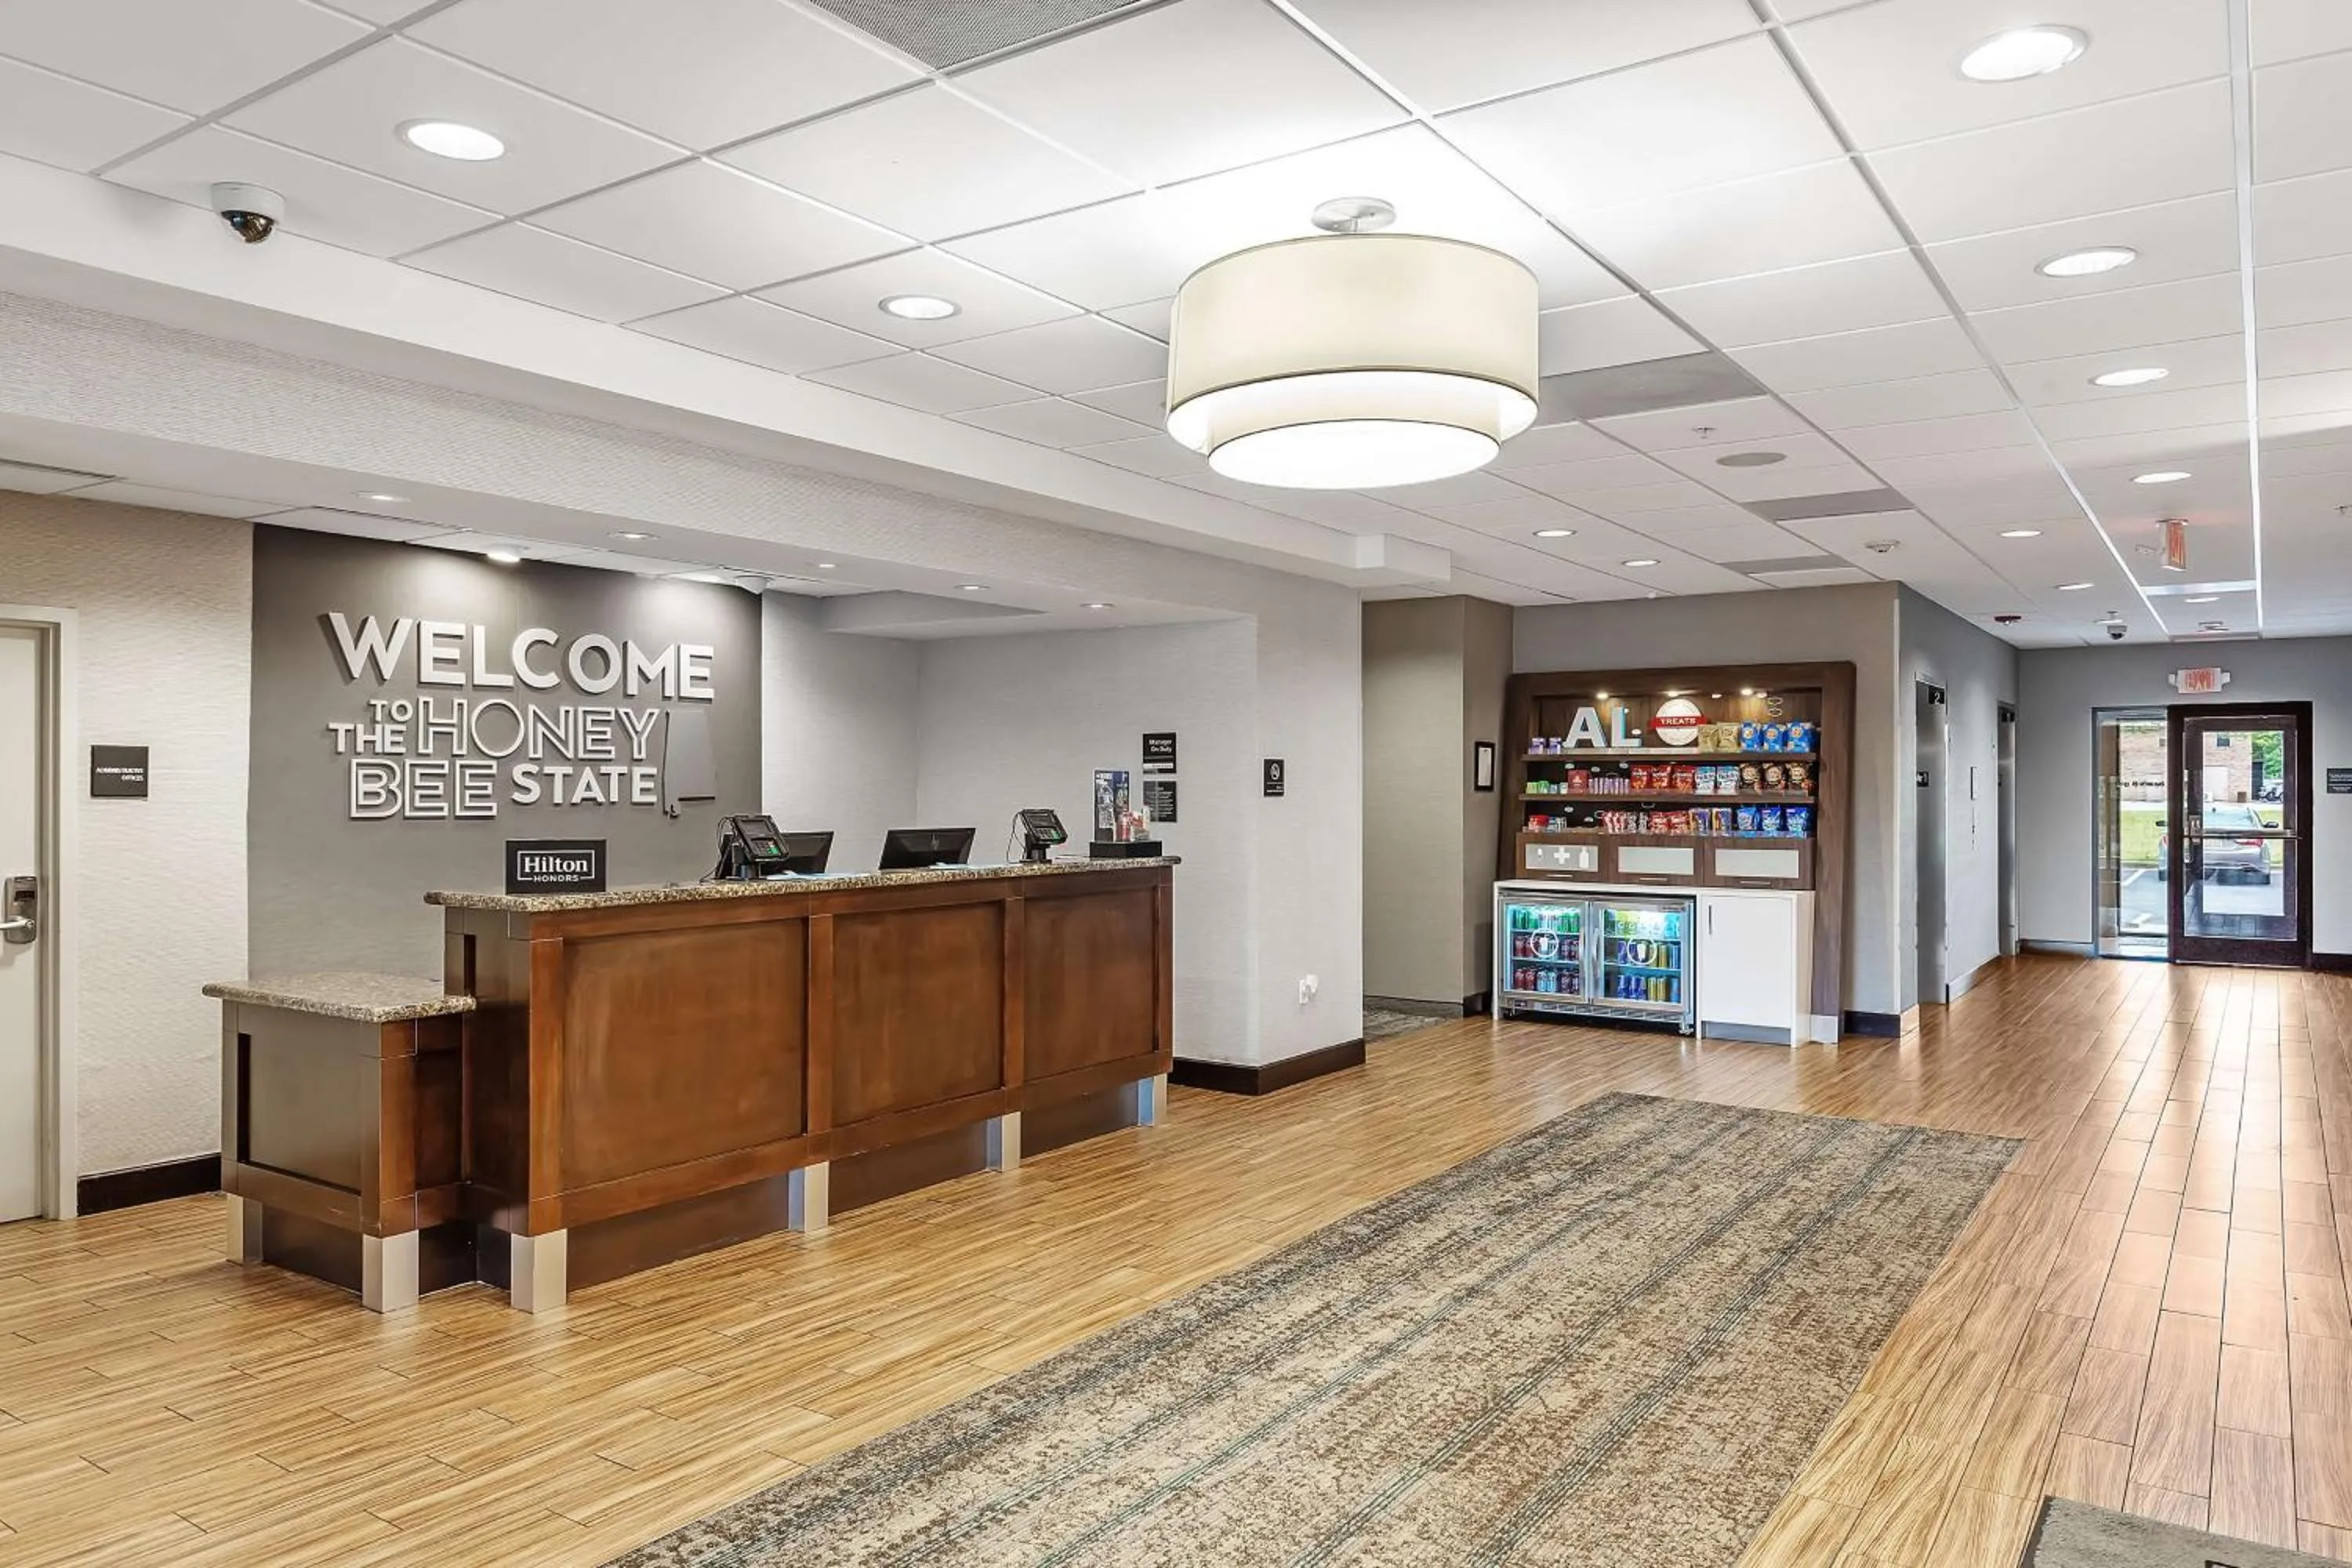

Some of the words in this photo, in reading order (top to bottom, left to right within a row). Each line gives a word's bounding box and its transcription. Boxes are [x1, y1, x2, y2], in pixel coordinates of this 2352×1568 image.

[327, 612, 715, 699] WELCOME
[368, 699, 413, 722] TO
[1660, 717, 1697, 726] TREATS
[328, 722, 407, 754] THE
[416, 696, 660, 760] HONEY
[350, 757, 498, 818] BEE
[510, 762, 659, 805] STATE
[524, 855, 588, 873] Hilton
[534, 874, 579, 883] HONORS
